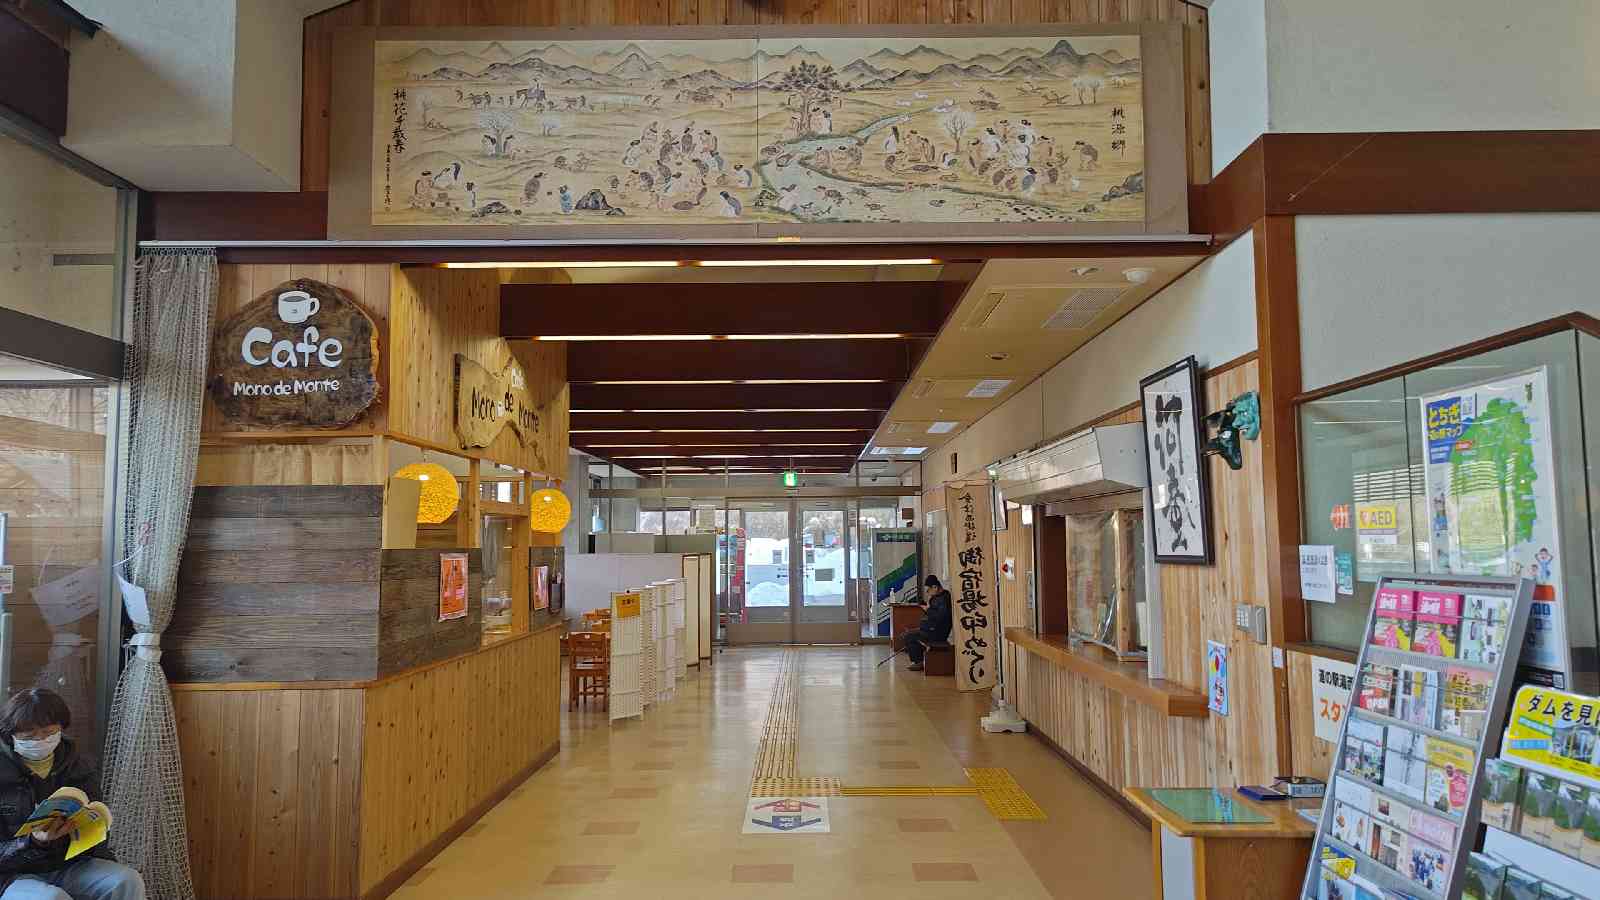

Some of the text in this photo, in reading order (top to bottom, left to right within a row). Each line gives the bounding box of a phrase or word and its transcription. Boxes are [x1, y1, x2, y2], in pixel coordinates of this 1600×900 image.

[241, 326, 343, 368] Cafe
[232, 378, 341, 397] Mono de Monte
[504, 384, 514, 414] de
[1428, 401, 1460, 429] とちぎ
[1371, 510, 1393, 526] AED
[956, 546, 989, 685] 御宿場印めぐり
[1527, 693, 1600, 728] ダムを見
